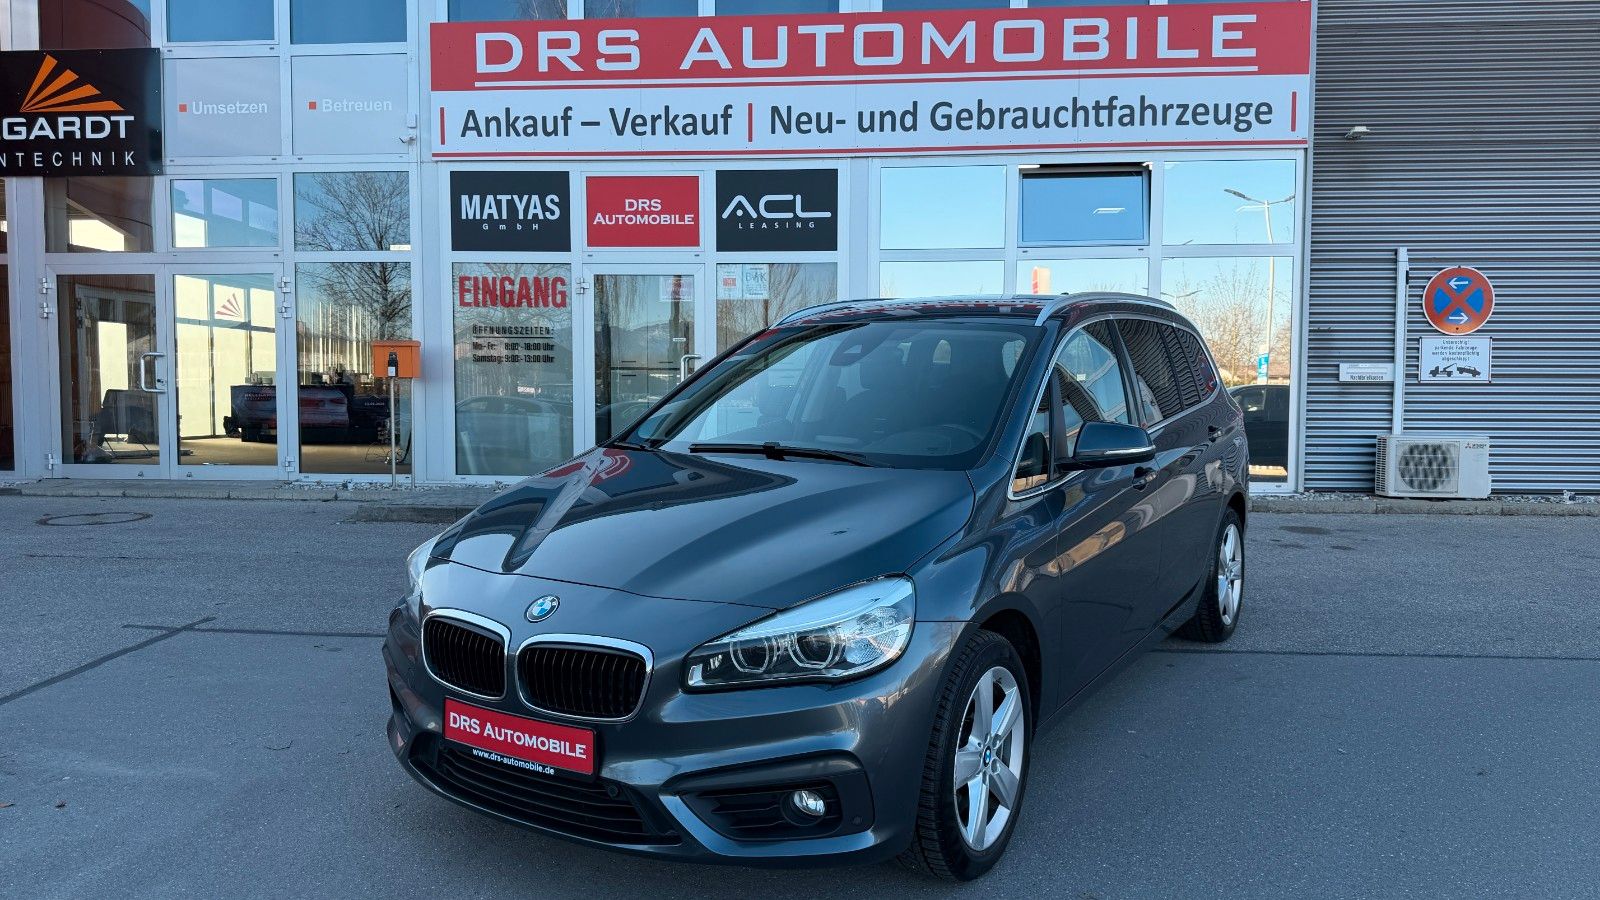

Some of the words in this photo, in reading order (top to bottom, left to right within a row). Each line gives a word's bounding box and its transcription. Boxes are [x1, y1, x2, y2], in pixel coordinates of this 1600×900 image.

[474, 28, 641, 74] DRS
[679, 14, 1257, 70] AUTOMOBILE
[192, 100, 268, 115] Umsetzen
[322, 98, 393, 113] Betreuen
[460, 106, 573, 138] Ankauf
[609, 104, 733, 137] Verkauf
[770, 104, 846, 135] Neu-
[857, 100, 919, 133] und
[929, 95, 1274, 133] Gebrauchtfahrzeuge
[0, 115, 135, 141] GARDT
[460, 194, 561, 221] MATYAS
[624, 199, 662, 212] DRS
[721, 194, 832, 219] ACL
[593, 212, 695, 226] AUTOMOBILE
[738, 221, 816, 230] LEASING
[458, 275, 568, 308] EINGANG
[472, 324, 555, 336] ÖFFNUNGSZEITEN:
[542, 342, 555, 351] Uhr
[472, 354, 504, 364] Samstag:
[542, 354, 555, 363] Uhr
[449, 711, 481, 735] DRS
[483, 722, 587, 760] AUTOMOBILE
[472, 748, 555, 776] www.drs-automobile.de
